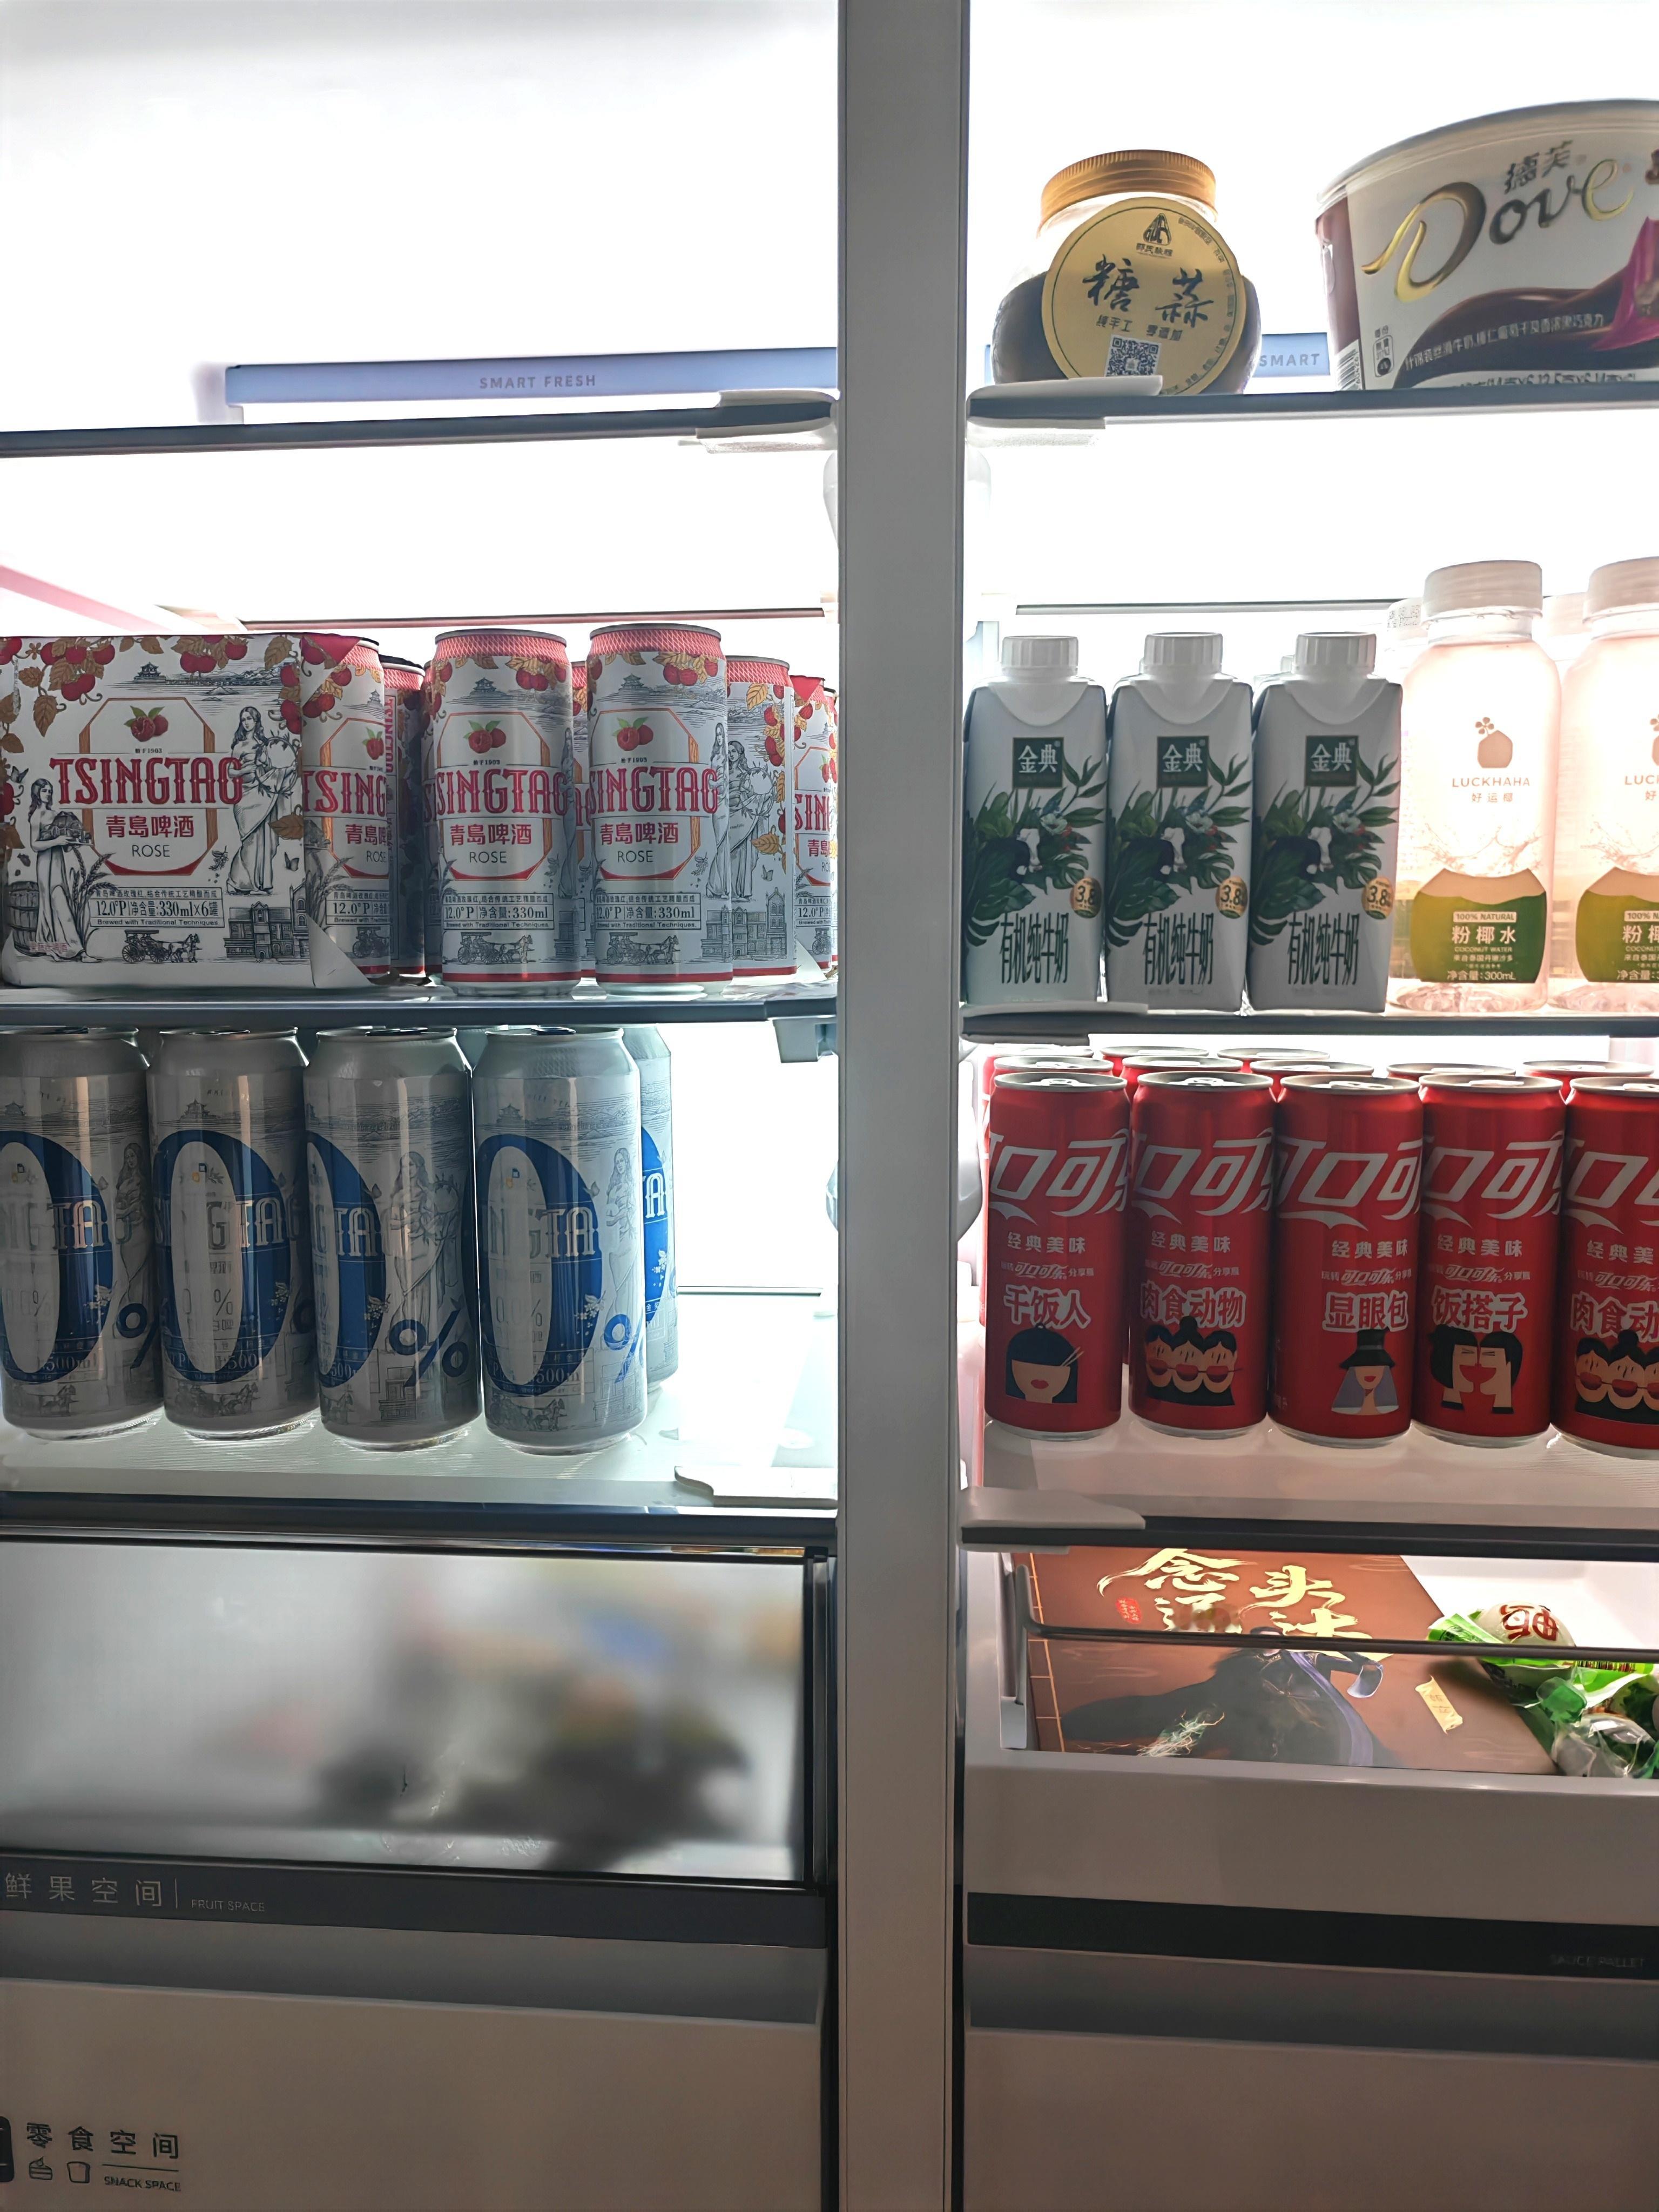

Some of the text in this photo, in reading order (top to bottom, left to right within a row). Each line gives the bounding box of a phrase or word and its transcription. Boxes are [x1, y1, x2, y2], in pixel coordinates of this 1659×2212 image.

[1361, 159, 1634, 302] Dove
[1259, 353, 1320, 367] SMART
[480, 375, 596, 389] SMART FRESH
[1017, 743, 1058, 774] 金典
[1162, 743, 1203, 773] 金典
[1310, 743, 1353, 773] 金典
[49, 757, 243, 805] TSINGTAO
[1452, 777, 1531, 788] LUCKHAHA
[1624, 774, 1659, 785] LUC
[132, 844, 171, 858] ROSE
[469, 851, 507, 864] ROSE
[617, 850, 653, 863] ROSE
[1455, 913, 1515, 921] 100% NATURAL
[1451, 925, 1517, 945] 粉椰水
[1001, 913, 1069, 984] 有机纯牛奶
[1143, 913, 1214, 986] 有机纯牛奶
[1287, 914, 1360, 986] 有机纯牛奶
[1007, 1231, 1086, 1254] 经典美味
[1151, 1230, 1231, 1253] 经典美味
[1332, 1239, 1408, 1257] 经典美味
[1437, 1233, 1523, 1257] 经典美味
[1586, 1239, 1654, 1265] 经典美
[1003, 1284, 1092, 1329] 干饭人
[1140, 1279, 1246, 1328] 肉食动物
[1322, 1289, 1409, 1333] 显眼包
[1431, 1285, 1529, 1334] 饭搭子
[4, 1872, 163, 1907] 鲜果空间
[191, 1899, 265, 1912] FRUIT SPACE
[26, 2122, 179, 2160] 零食空间
[104, 2176, 181, 2192] SNACK SPACE
